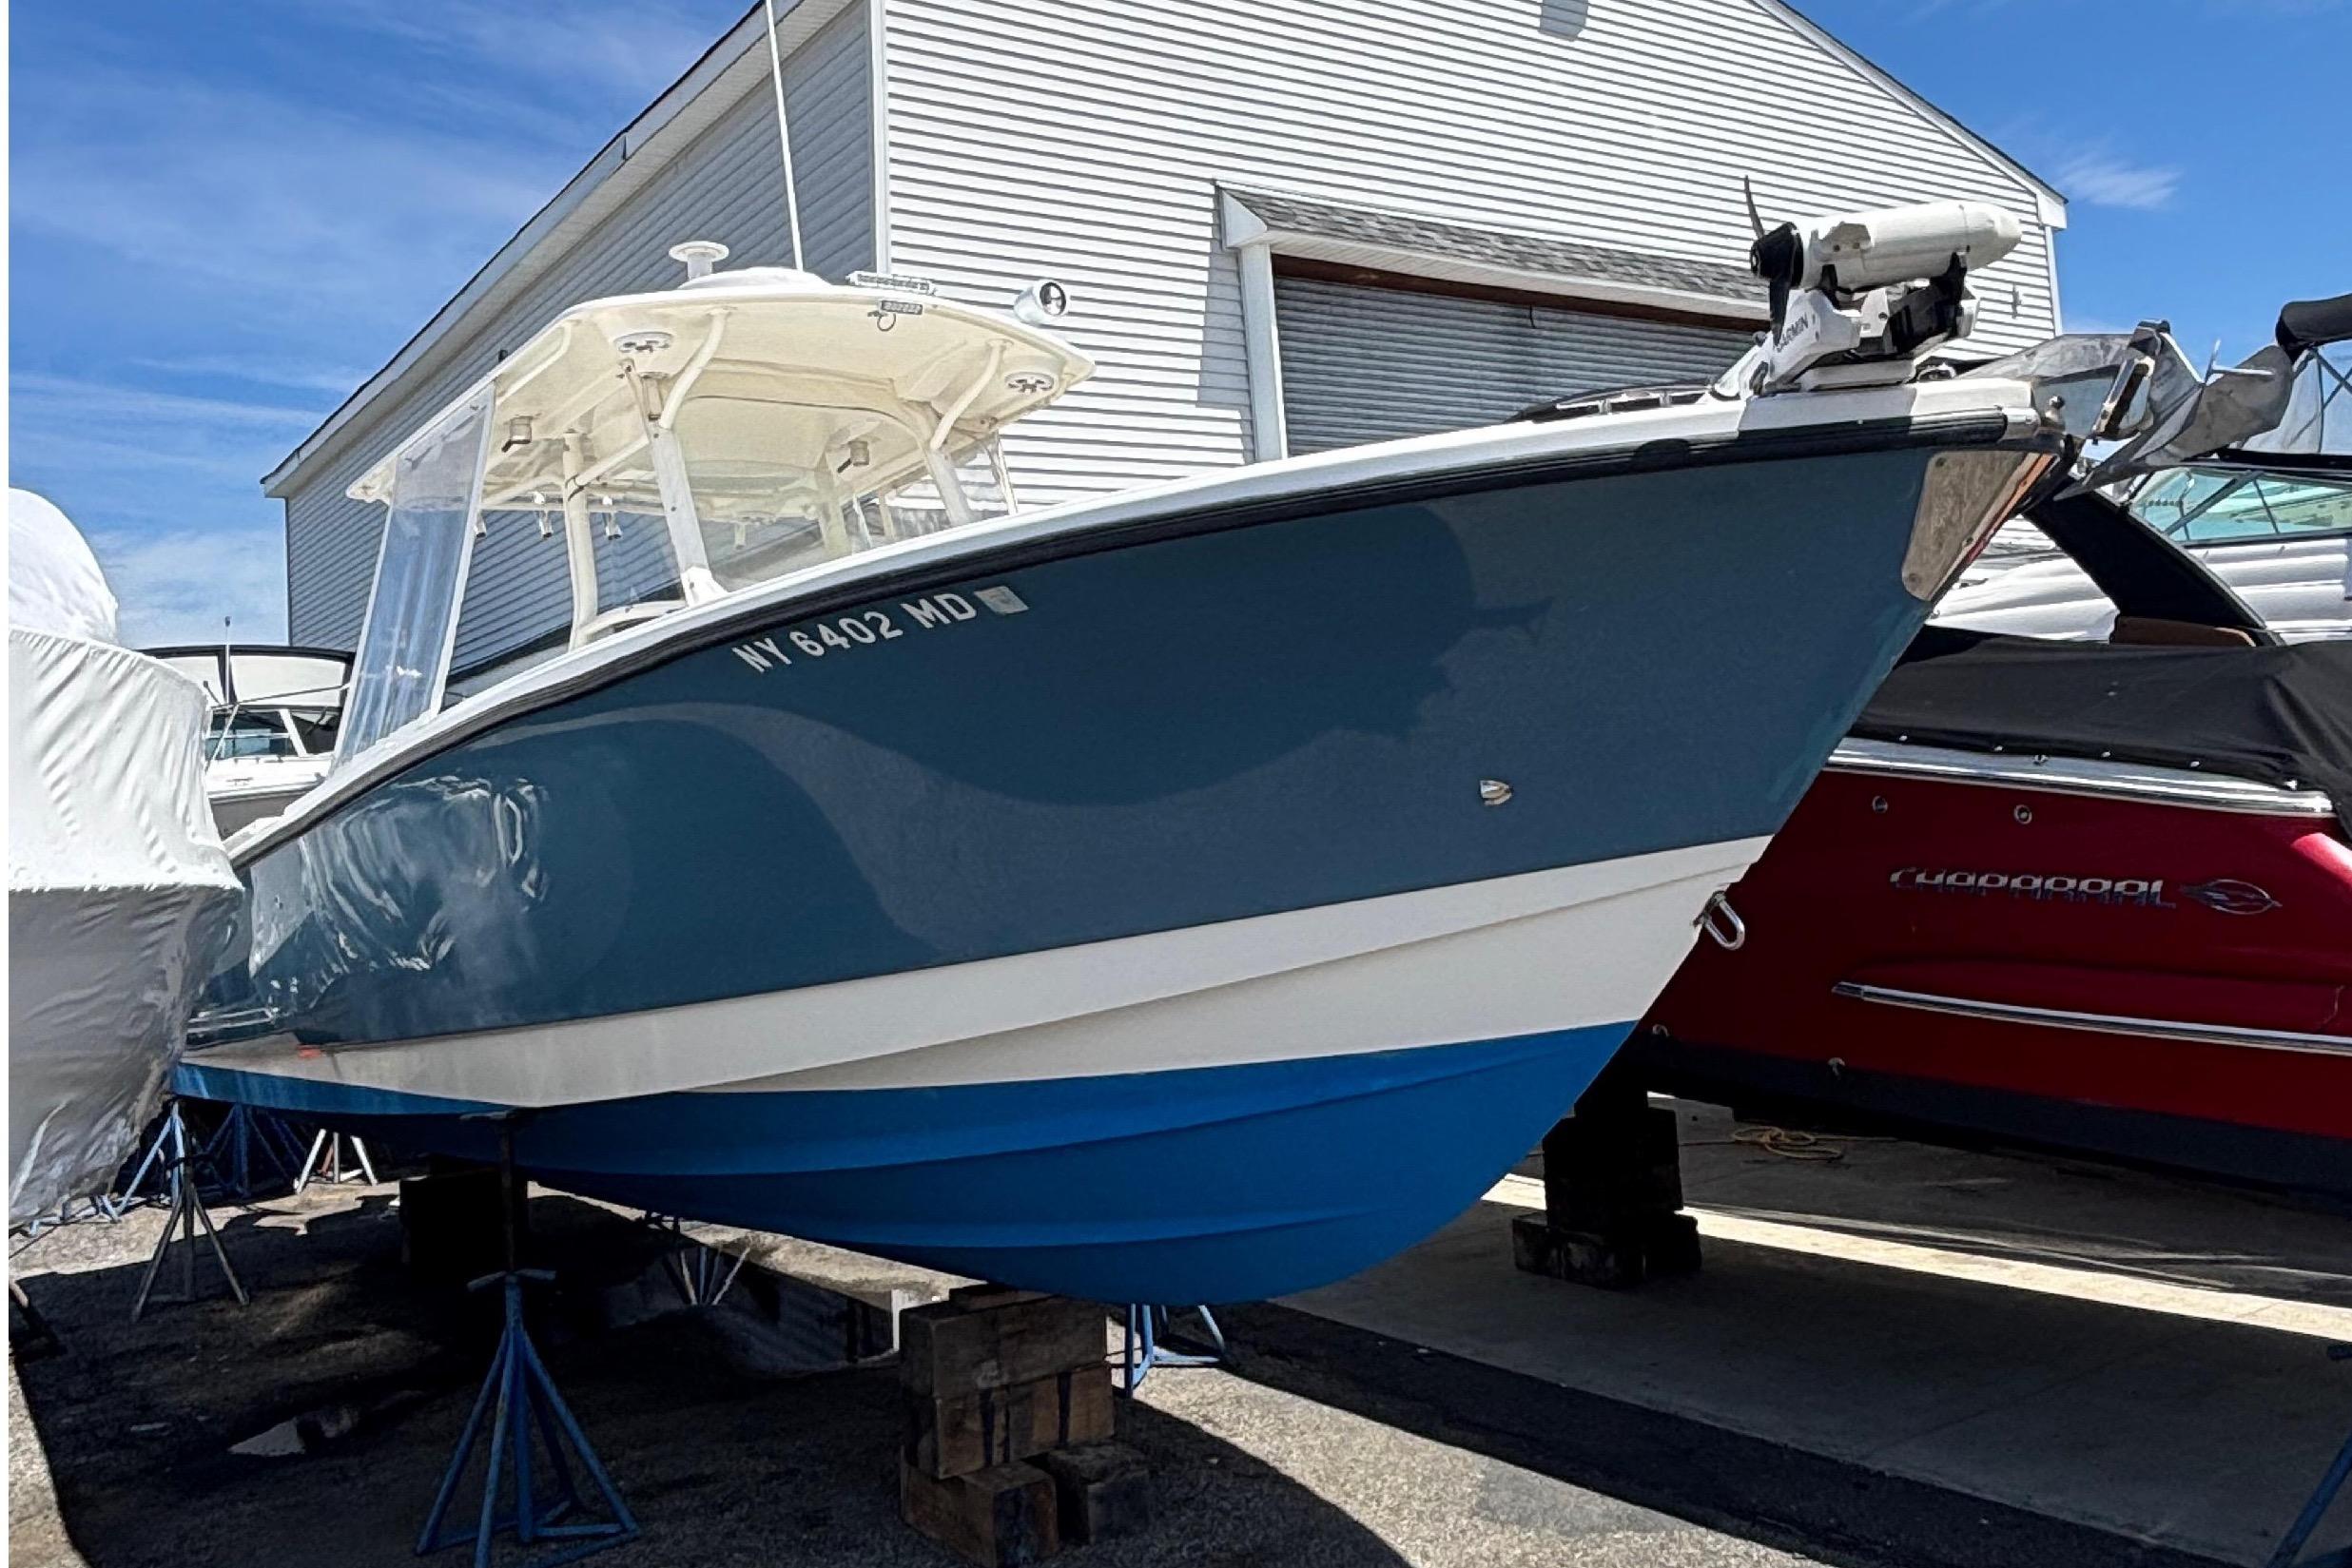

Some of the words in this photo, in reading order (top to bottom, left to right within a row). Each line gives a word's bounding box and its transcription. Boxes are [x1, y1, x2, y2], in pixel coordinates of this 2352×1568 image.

[732, 638, 792, 673] NY
[789, 611, 903, 657] 6402
[900, 593, 977, 629] MD
